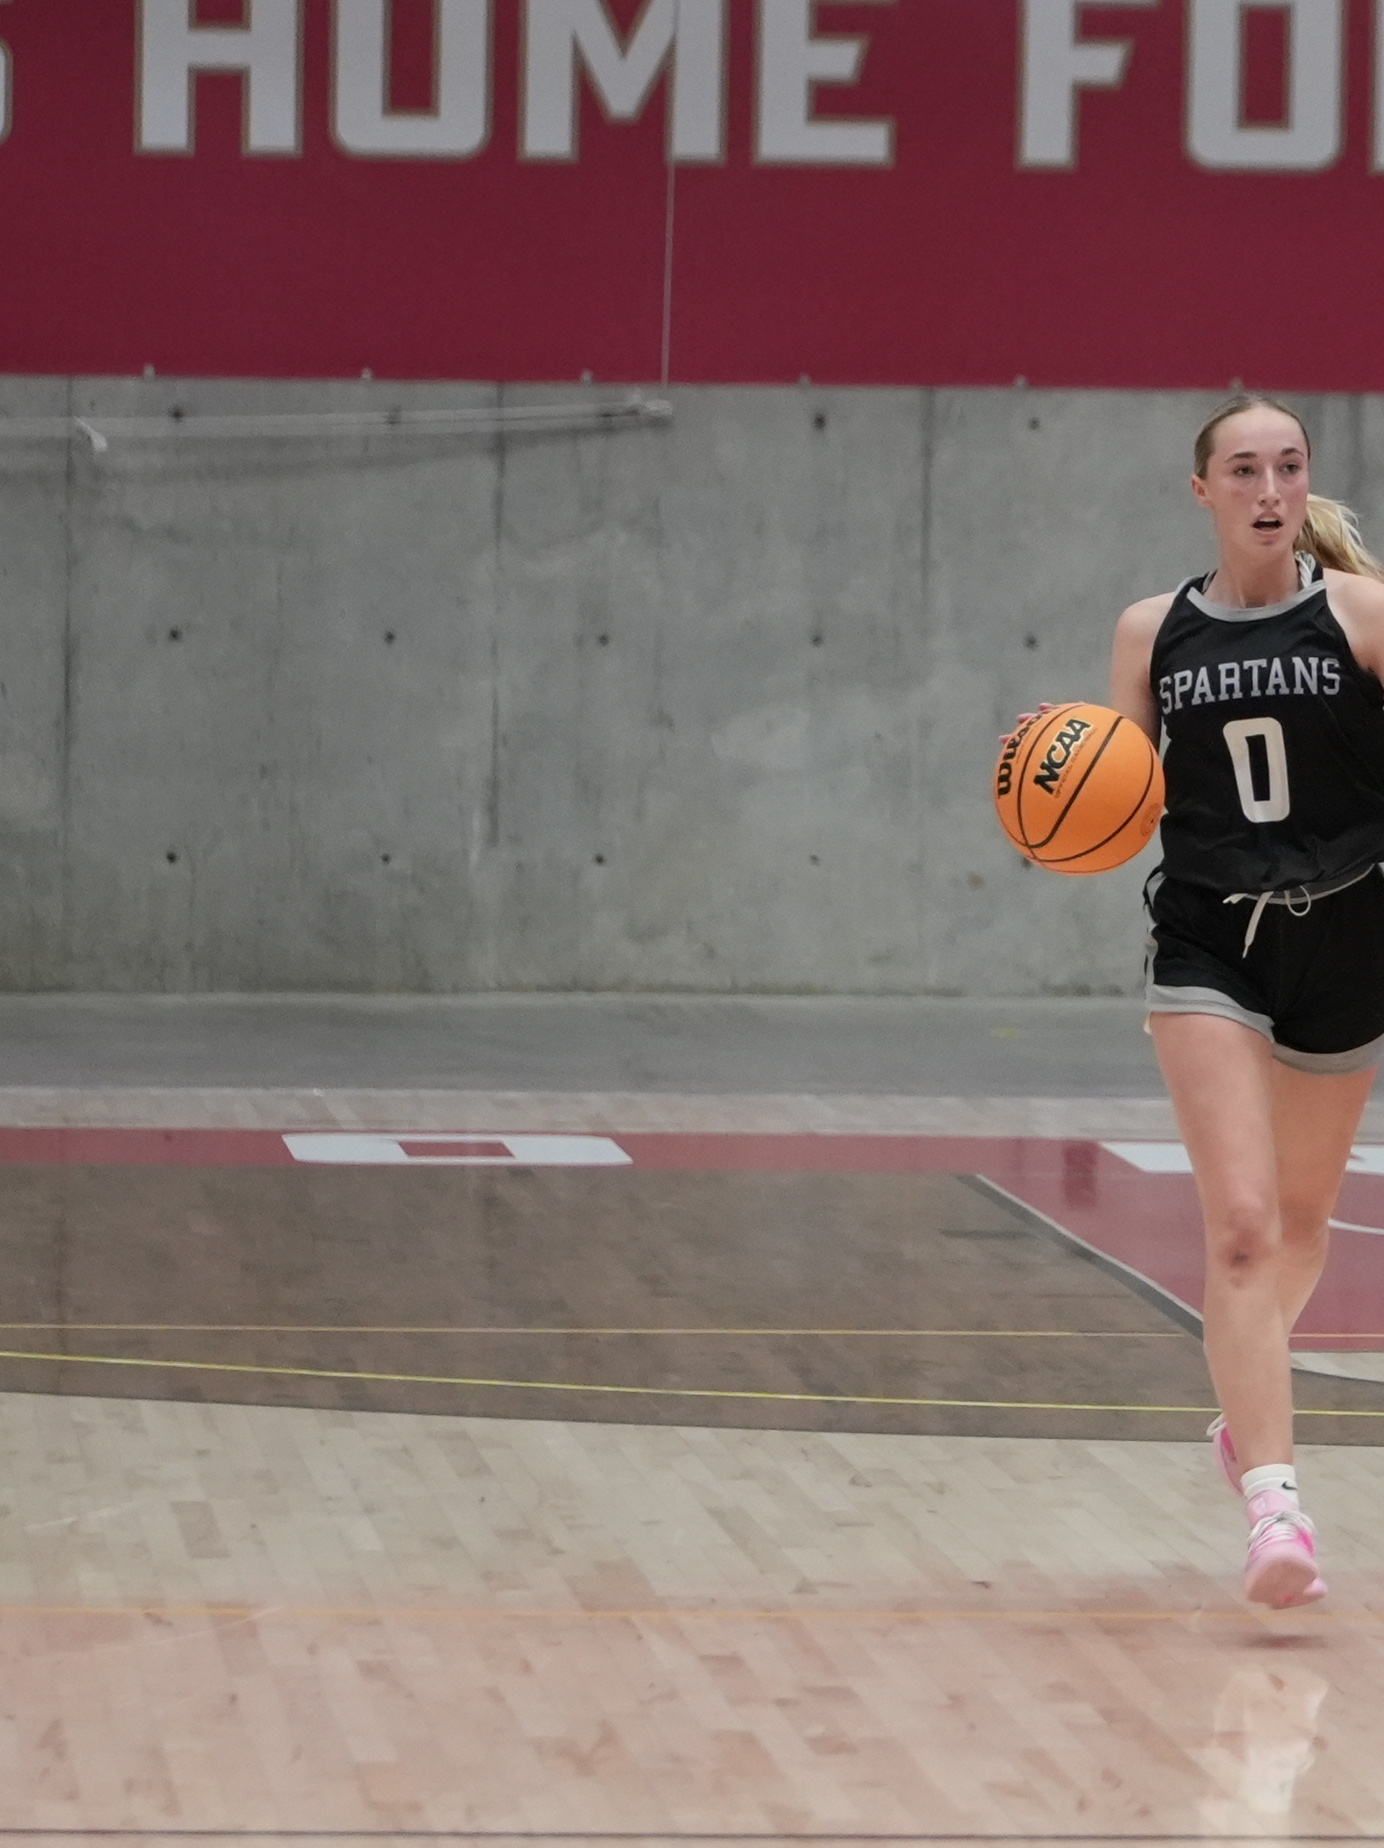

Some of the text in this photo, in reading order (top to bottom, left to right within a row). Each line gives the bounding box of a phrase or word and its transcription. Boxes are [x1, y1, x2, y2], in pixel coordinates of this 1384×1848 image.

[134, 0, 896, 167] HOME
[1159, 656, 1342, 715] SPARTANS
[1033, 718, 1093, 795] NCAA
[1222, 717, 1290, 823] 0
